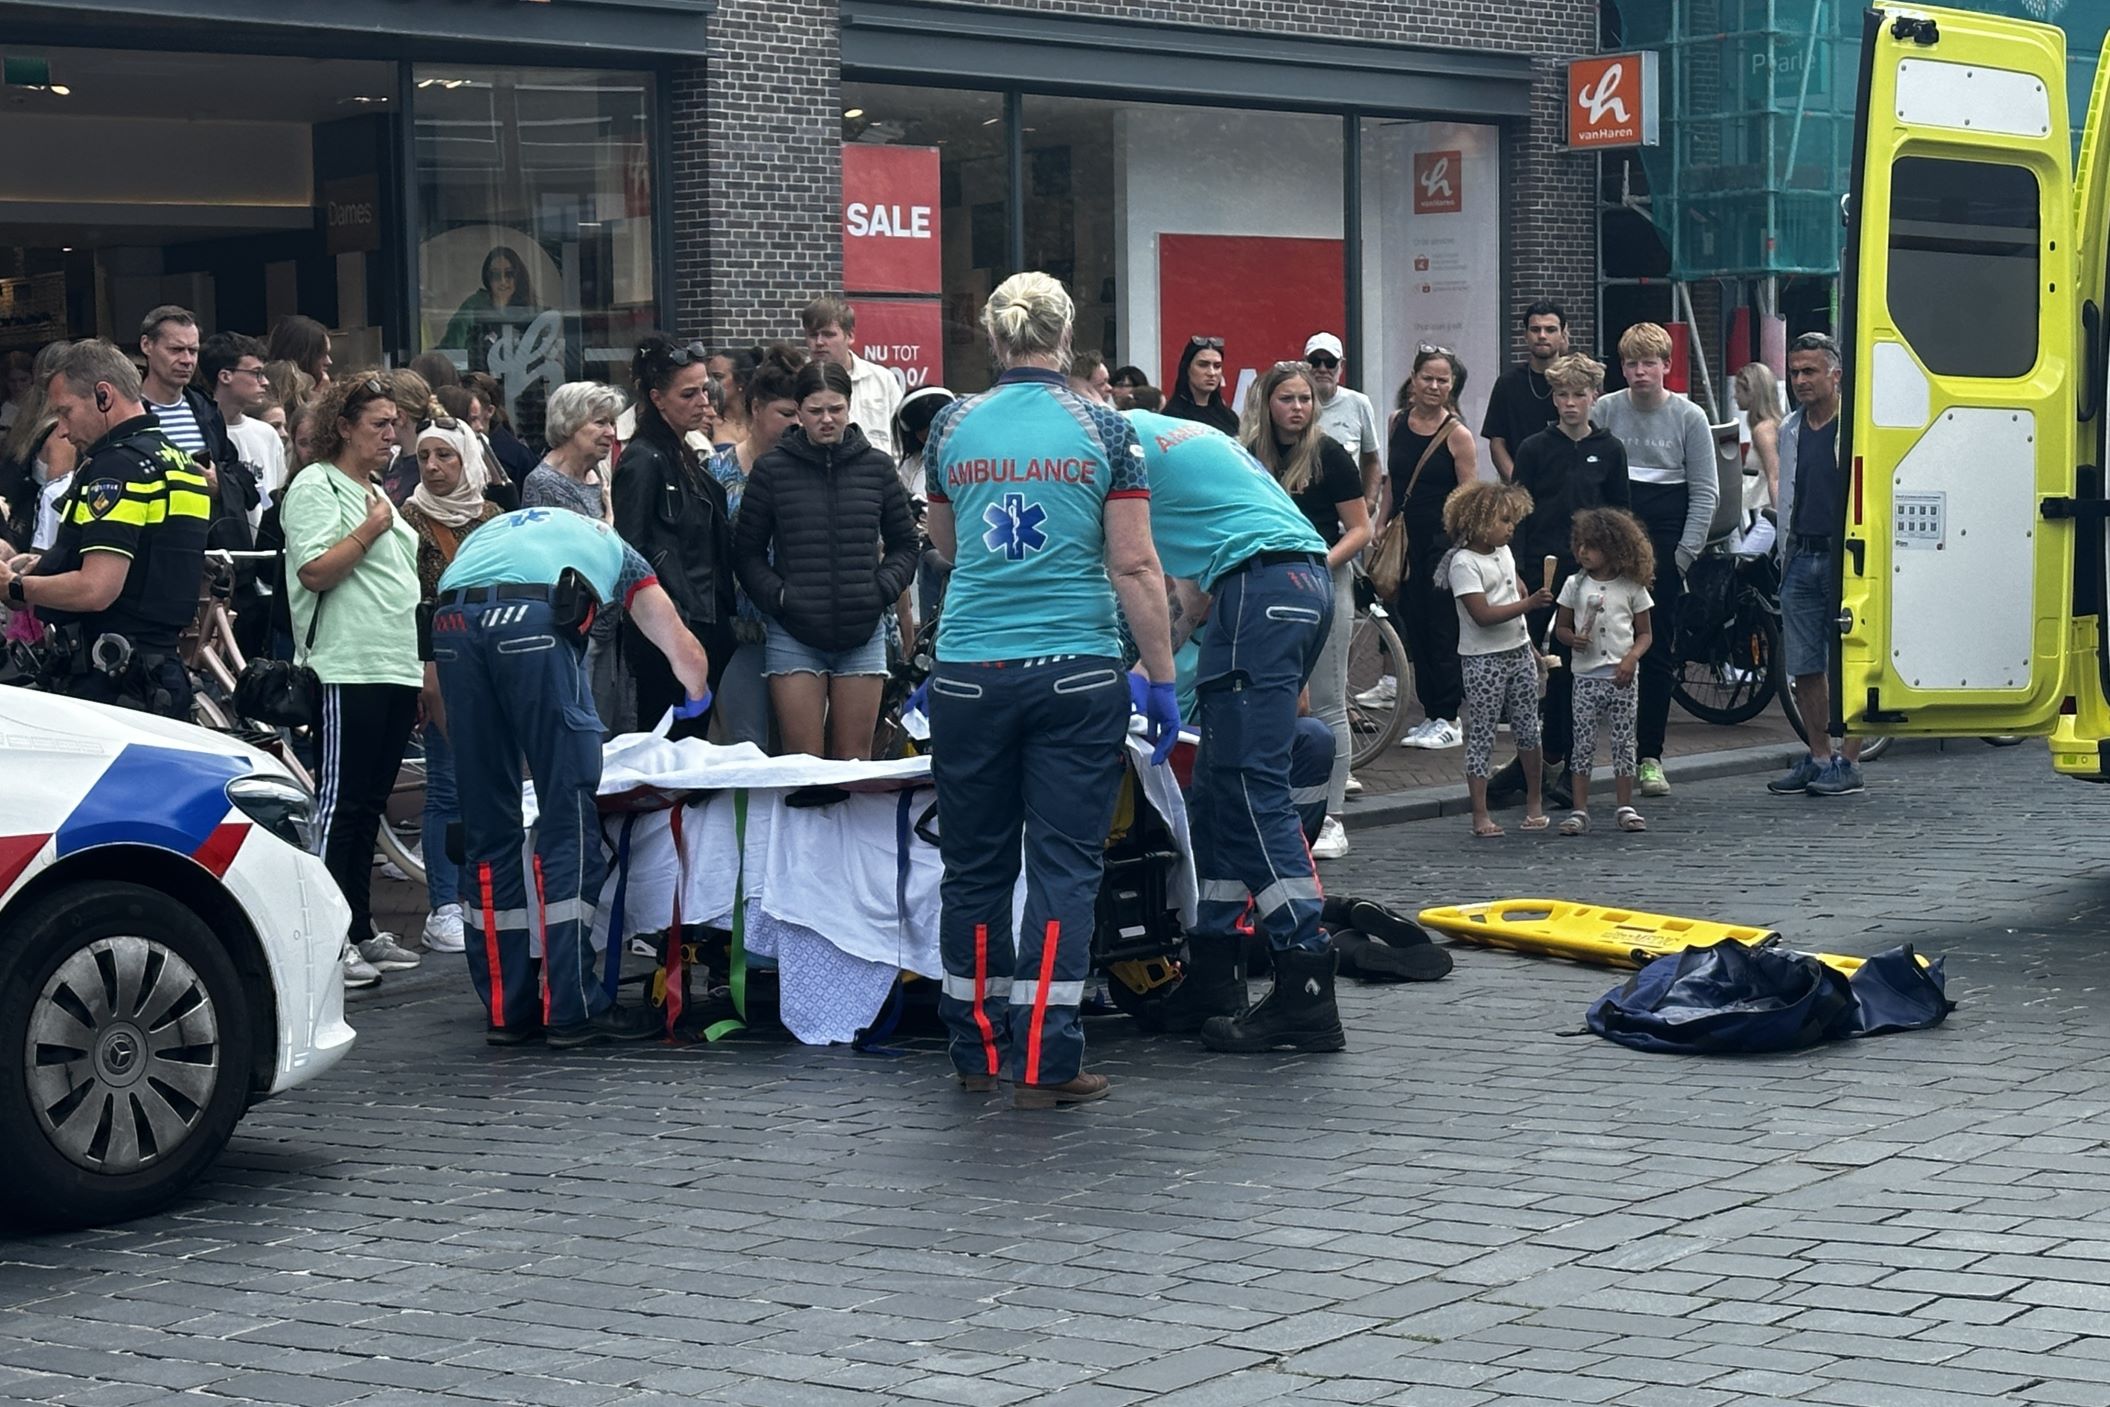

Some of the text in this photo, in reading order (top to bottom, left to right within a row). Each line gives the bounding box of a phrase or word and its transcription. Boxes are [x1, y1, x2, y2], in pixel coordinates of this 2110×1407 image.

[1578, 128, 1633, 140] vanHaren
[327, 201, 372, 226] Dames
[846, 202, 931, 238] SALE
[864, 345, 920, 361] NU TOT
[948, 458, 1097, 488] AMBULANCE
